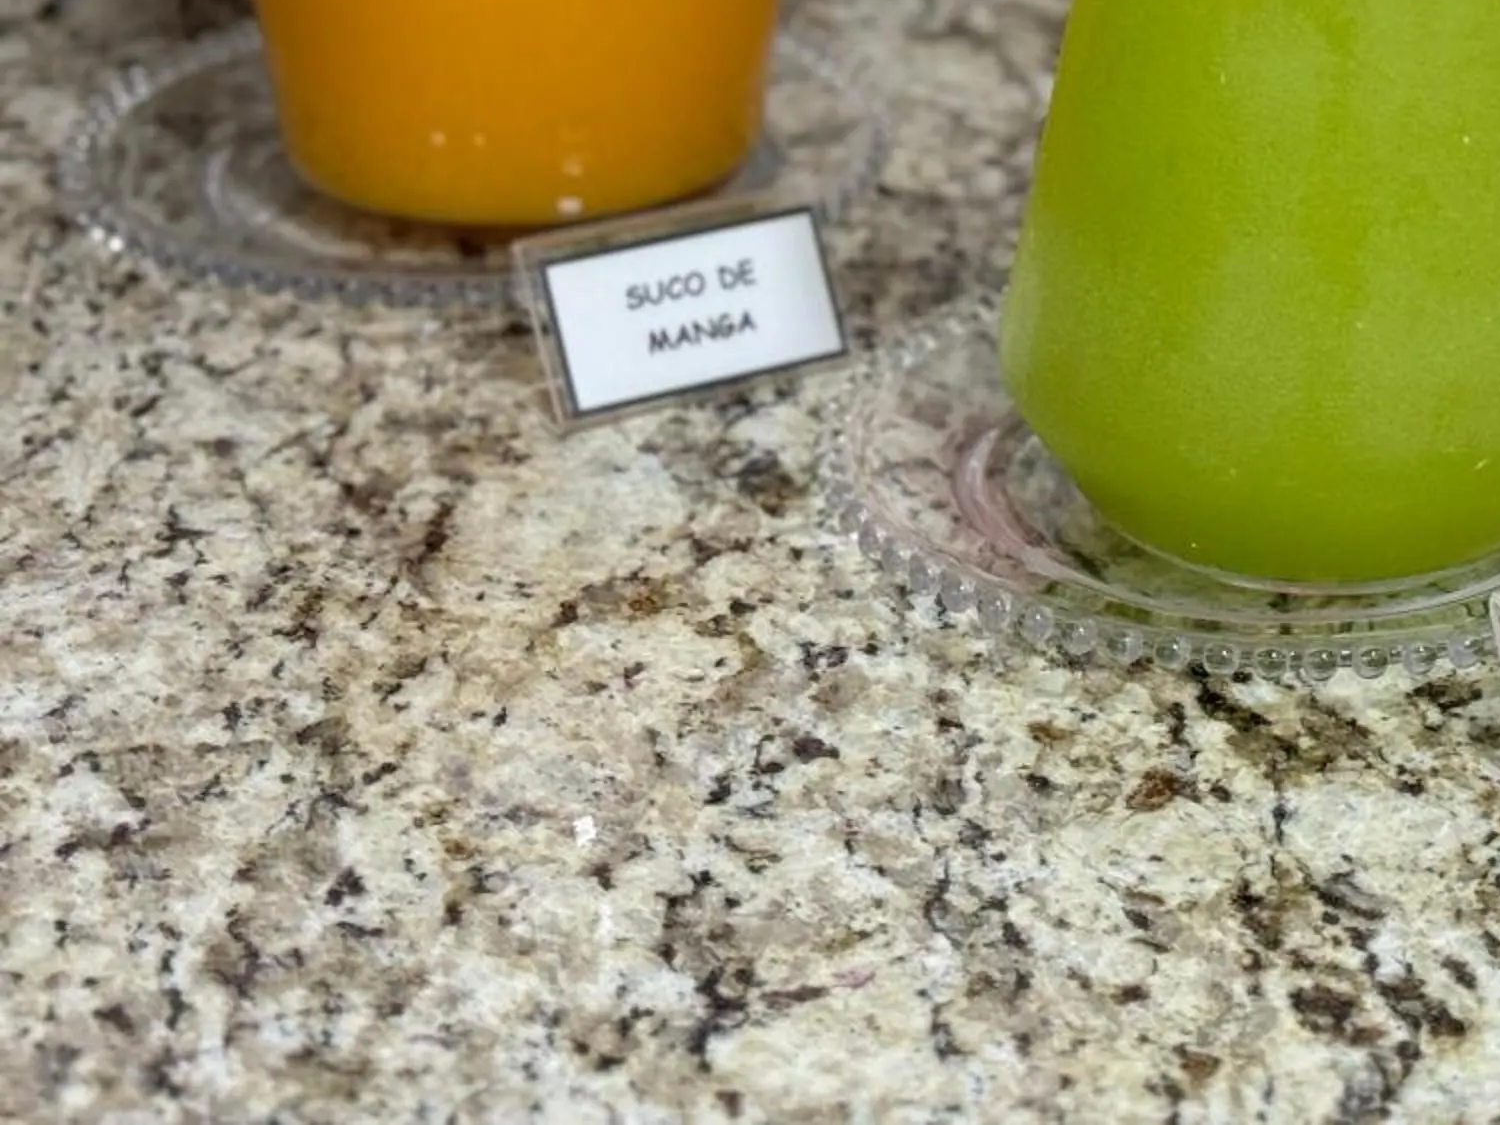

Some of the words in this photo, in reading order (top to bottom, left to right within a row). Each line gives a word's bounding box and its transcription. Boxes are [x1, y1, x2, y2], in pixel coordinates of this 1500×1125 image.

[625, 271, 706, 310] SUCO
[718, 258, 756, 289] DE
[648, 311, 756, 355] MANGA
